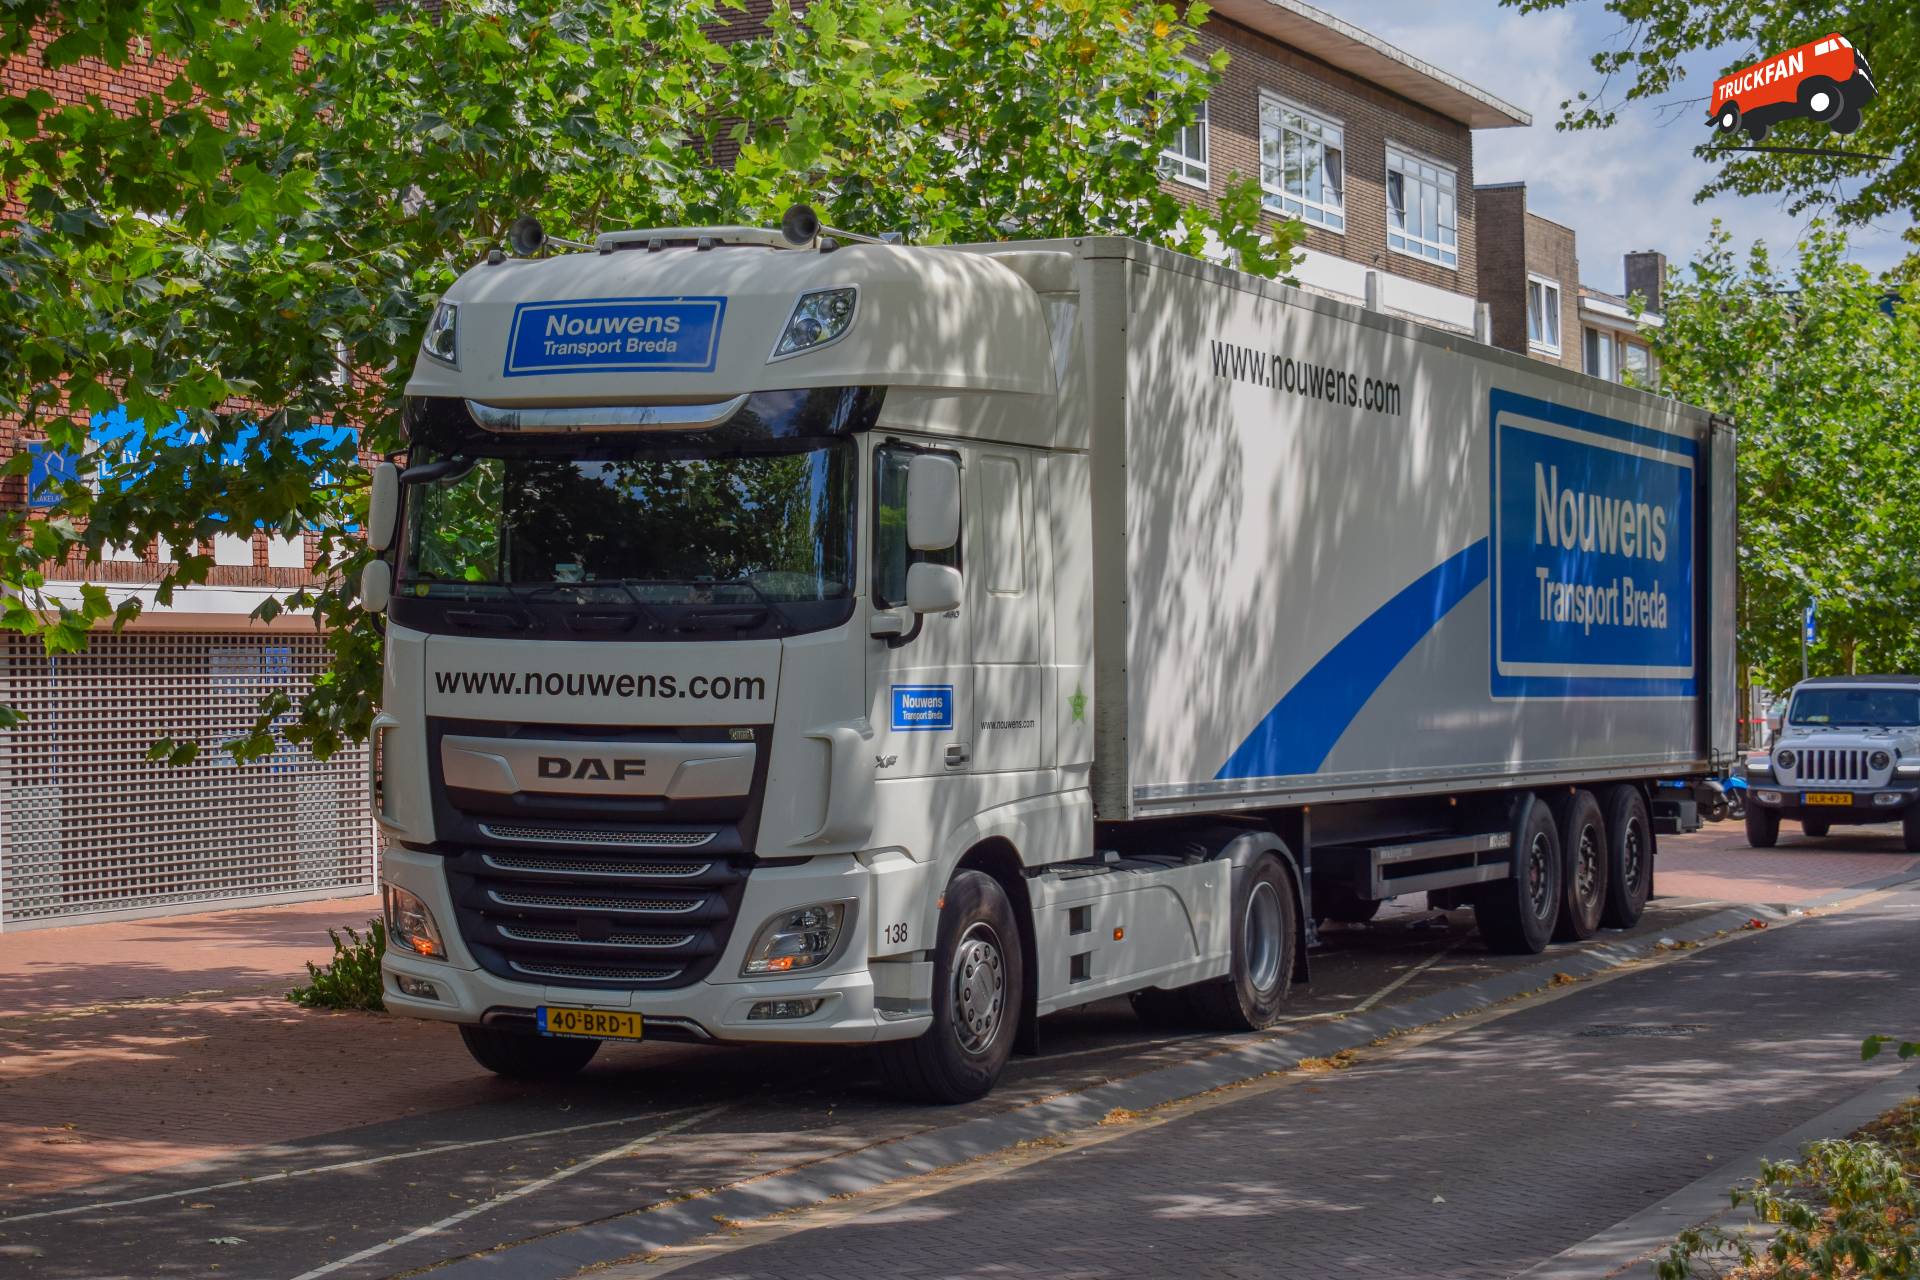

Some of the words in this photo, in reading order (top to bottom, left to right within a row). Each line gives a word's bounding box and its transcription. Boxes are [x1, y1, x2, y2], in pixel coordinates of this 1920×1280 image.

[545, 314, 680, 336] Nouwens
[543, 339, 621, 357] Transport
[626, 337, 678, 353] Breda
[1211, 339, 1401, 416] www.nouwens.com
[1535, 462, 1666, 562] Nouwens
[1536, 566, 1619, 636] Transport
[1622, 576, 1668, 629] Breda
[434, 671, 766, 700] www.nouwens.com
[902, 694, 943, 709] Nouwens
[902, 710, 928, 721] Transport
[928, 710, 943, 720] Breda
[980, 719, 1035, 730] www.nouwens.com
[537, 756, 647, 781] DAF
[884, 922, 907, 944] 138
[553, 1012, 633, 1034] 40-BRD-1
